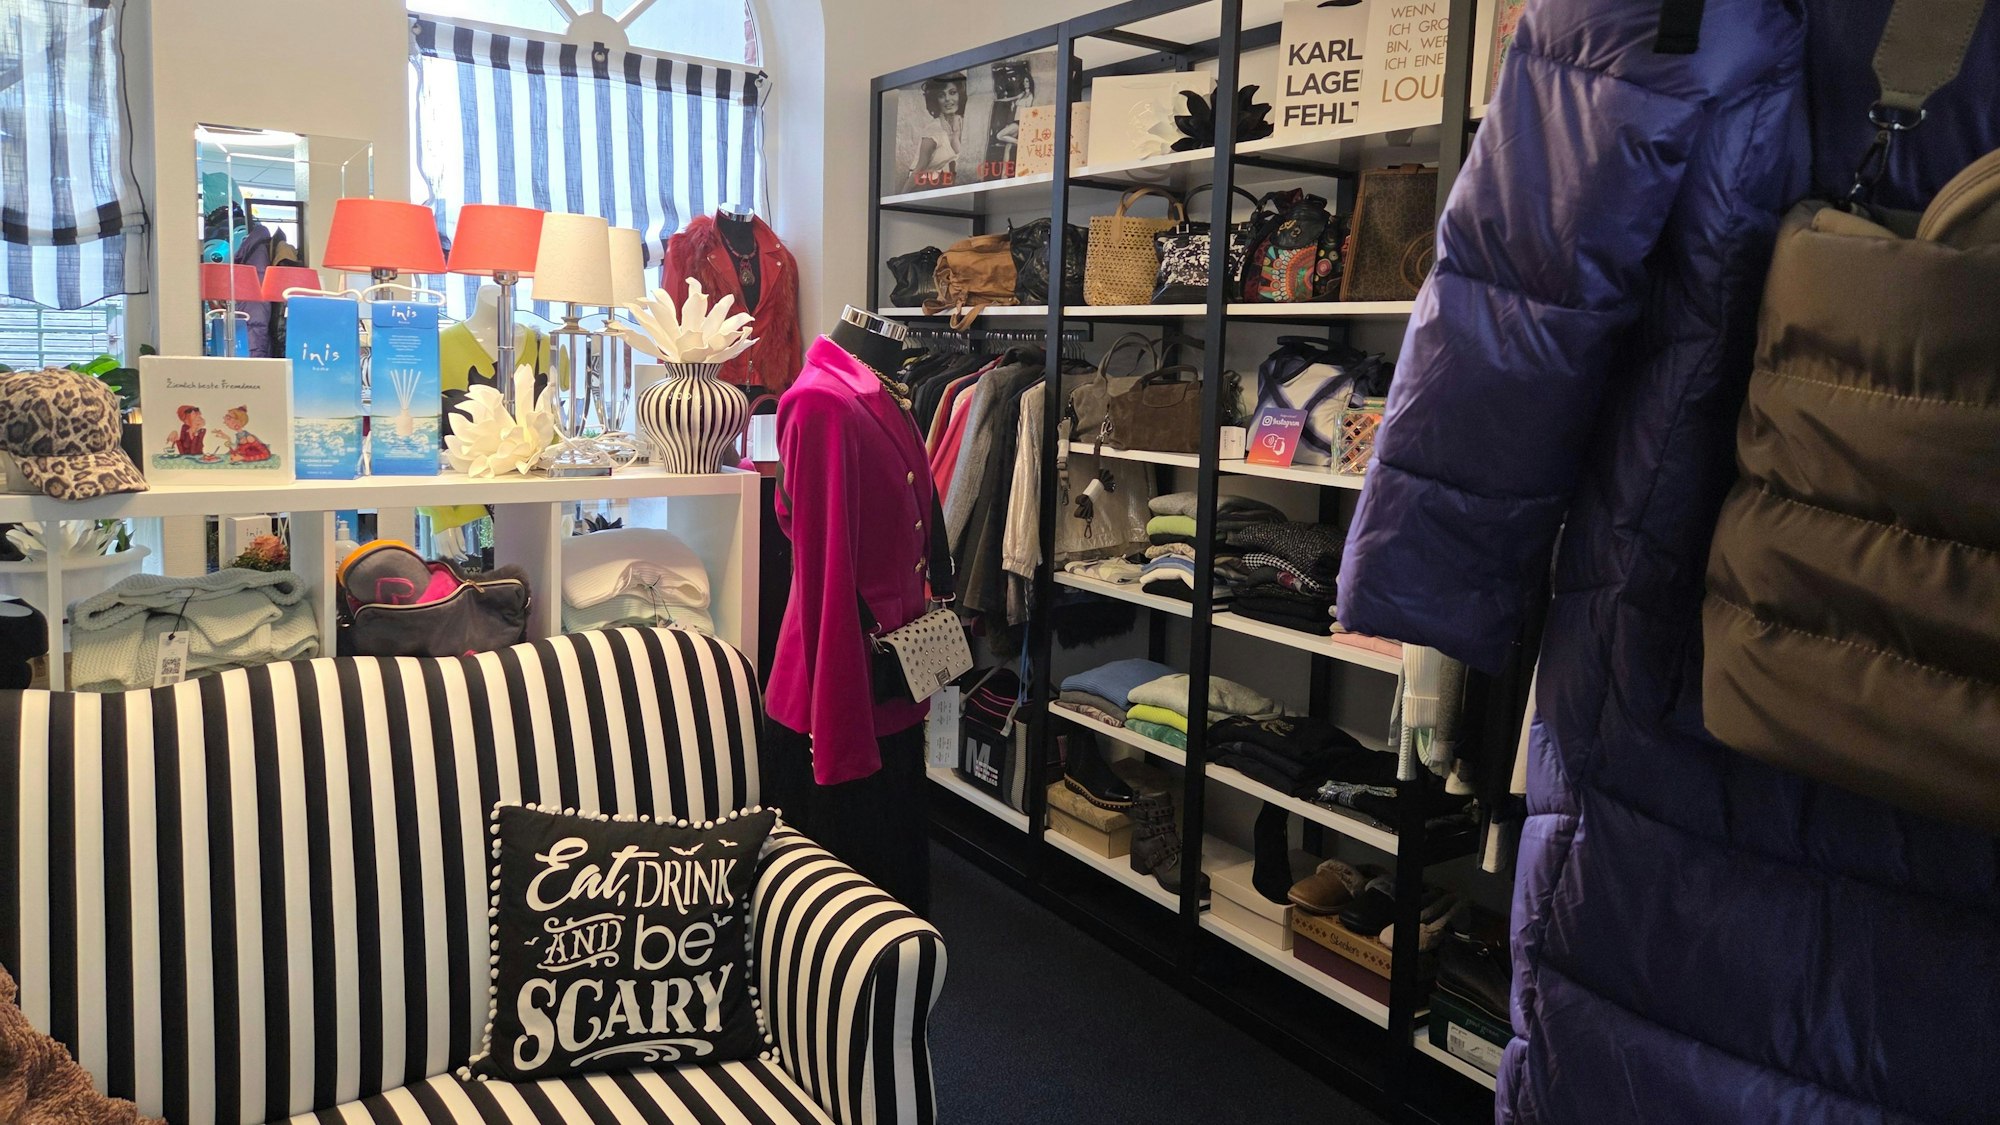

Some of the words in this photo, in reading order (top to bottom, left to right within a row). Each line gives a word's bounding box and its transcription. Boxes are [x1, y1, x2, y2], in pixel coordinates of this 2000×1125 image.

[1391, 2, 1436, 18] WENN
[1388, 22, 1411, 36] ICH
[1418, 17, 1449, 33] GRO
[1288, 38, 1363, 66] KARL
[1386, 40, 1412, 54] BIN,
[1384, 56, 1407, 70] ICH
[1414, 52, 1444, 68] EINE
[1286, 69, 1361, 97] LAGE
[977, 160, 1016, 178] GUE
[914, 171, 954, 186] GUE
[391, 305, 417, 321] inis
[302, 342, 340, 366] inis
[1273, 418, 1299, 428] Instagram
[634, 858, 737, 915] DRINK
[544, 919, 623, 966] AND
[634, 914, 717, 971] be
[513, 962, 734, 1071] SCARY
